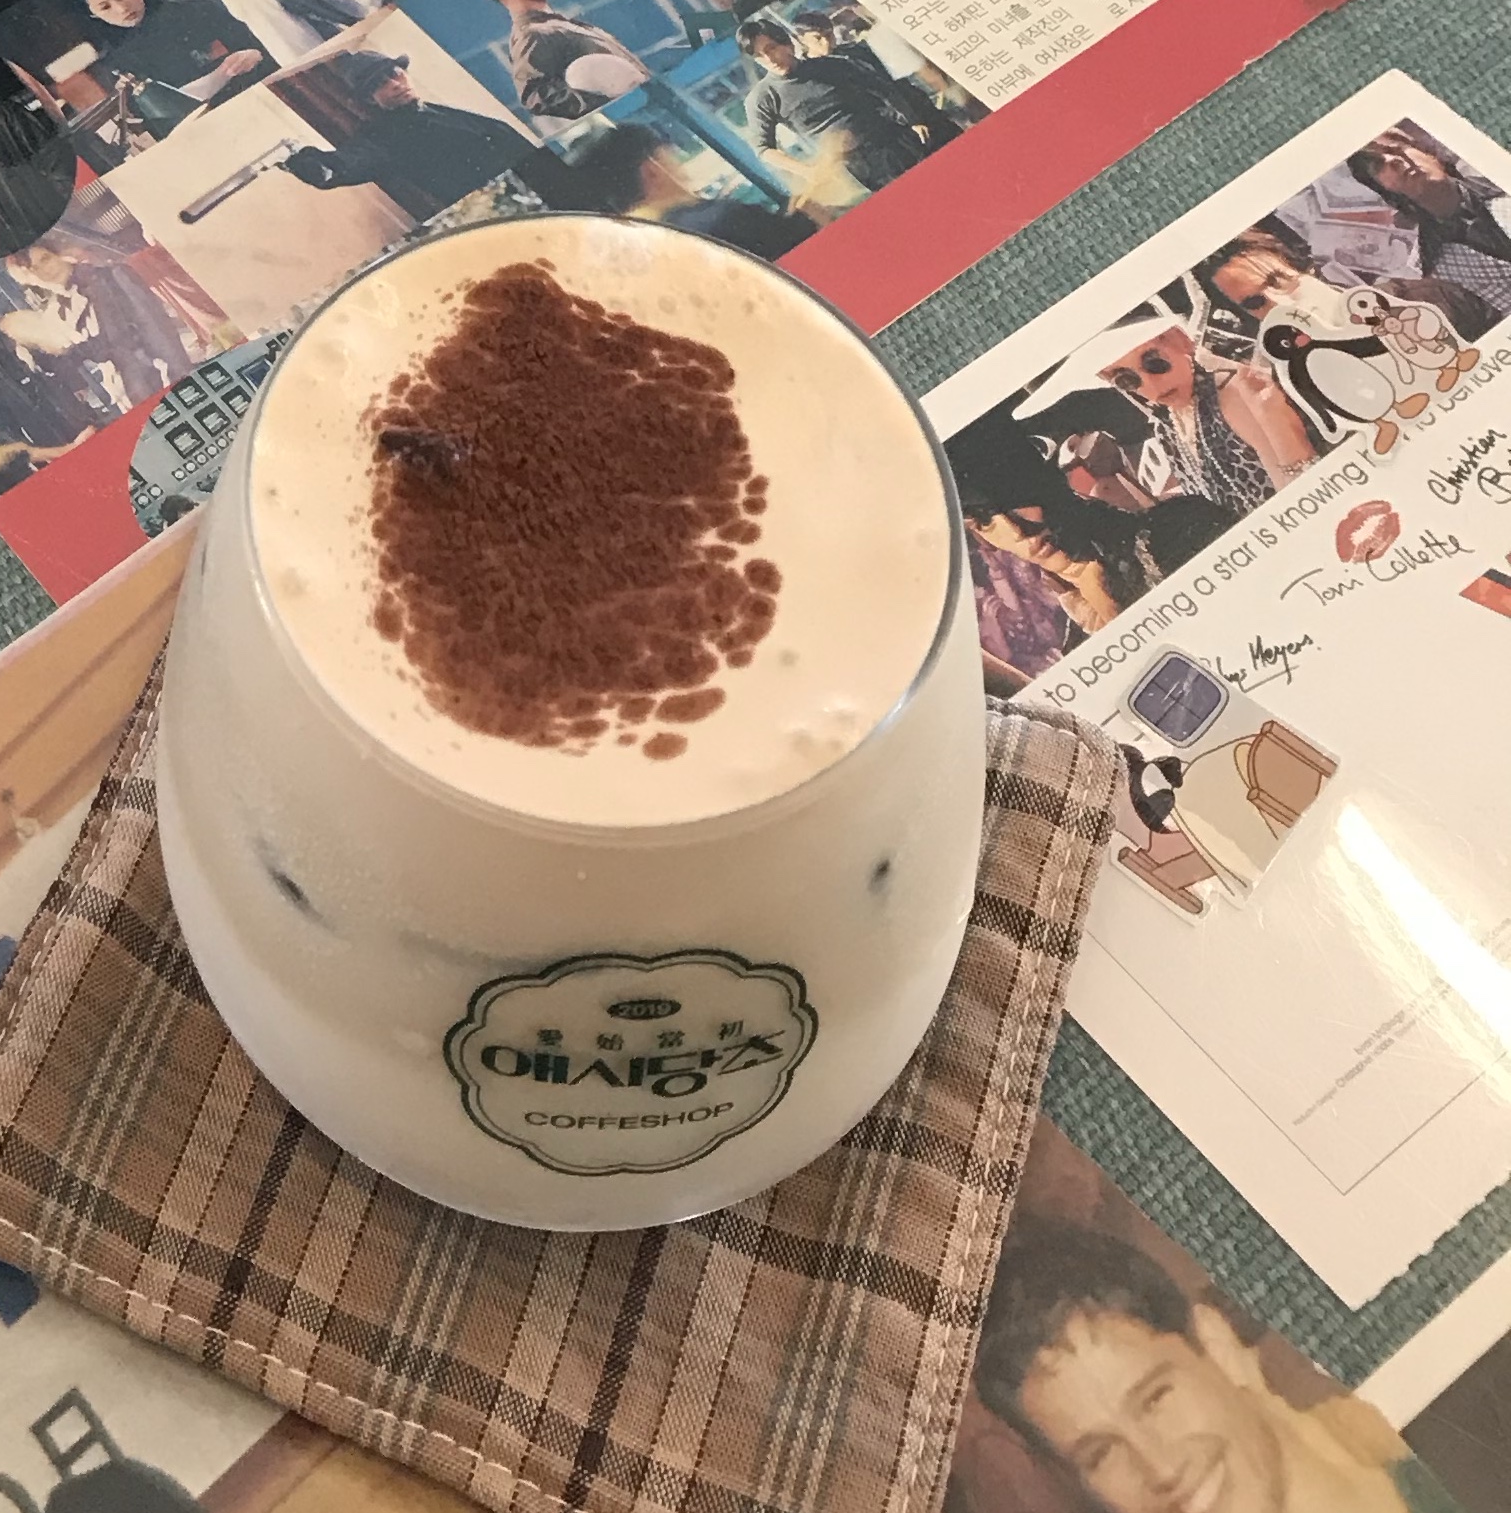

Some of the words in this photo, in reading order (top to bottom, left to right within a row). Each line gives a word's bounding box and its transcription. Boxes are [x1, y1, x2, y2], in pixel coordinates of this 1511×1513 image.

[1042, 682, 1076, 715] to
[1076, 592, 1198, 686] becoming
[1192, 574, 1217, 596] a
[1212, 541, 1257, 580] star
[1250, 527, 1278, 548] is
[1272, 462, 1368, 531] knowing
[617, 1000, 675, 1018] 2019
[480, 1029, 786, 1098] 애시당초
[523, 1100, 735, 1130] COFFESHOP
